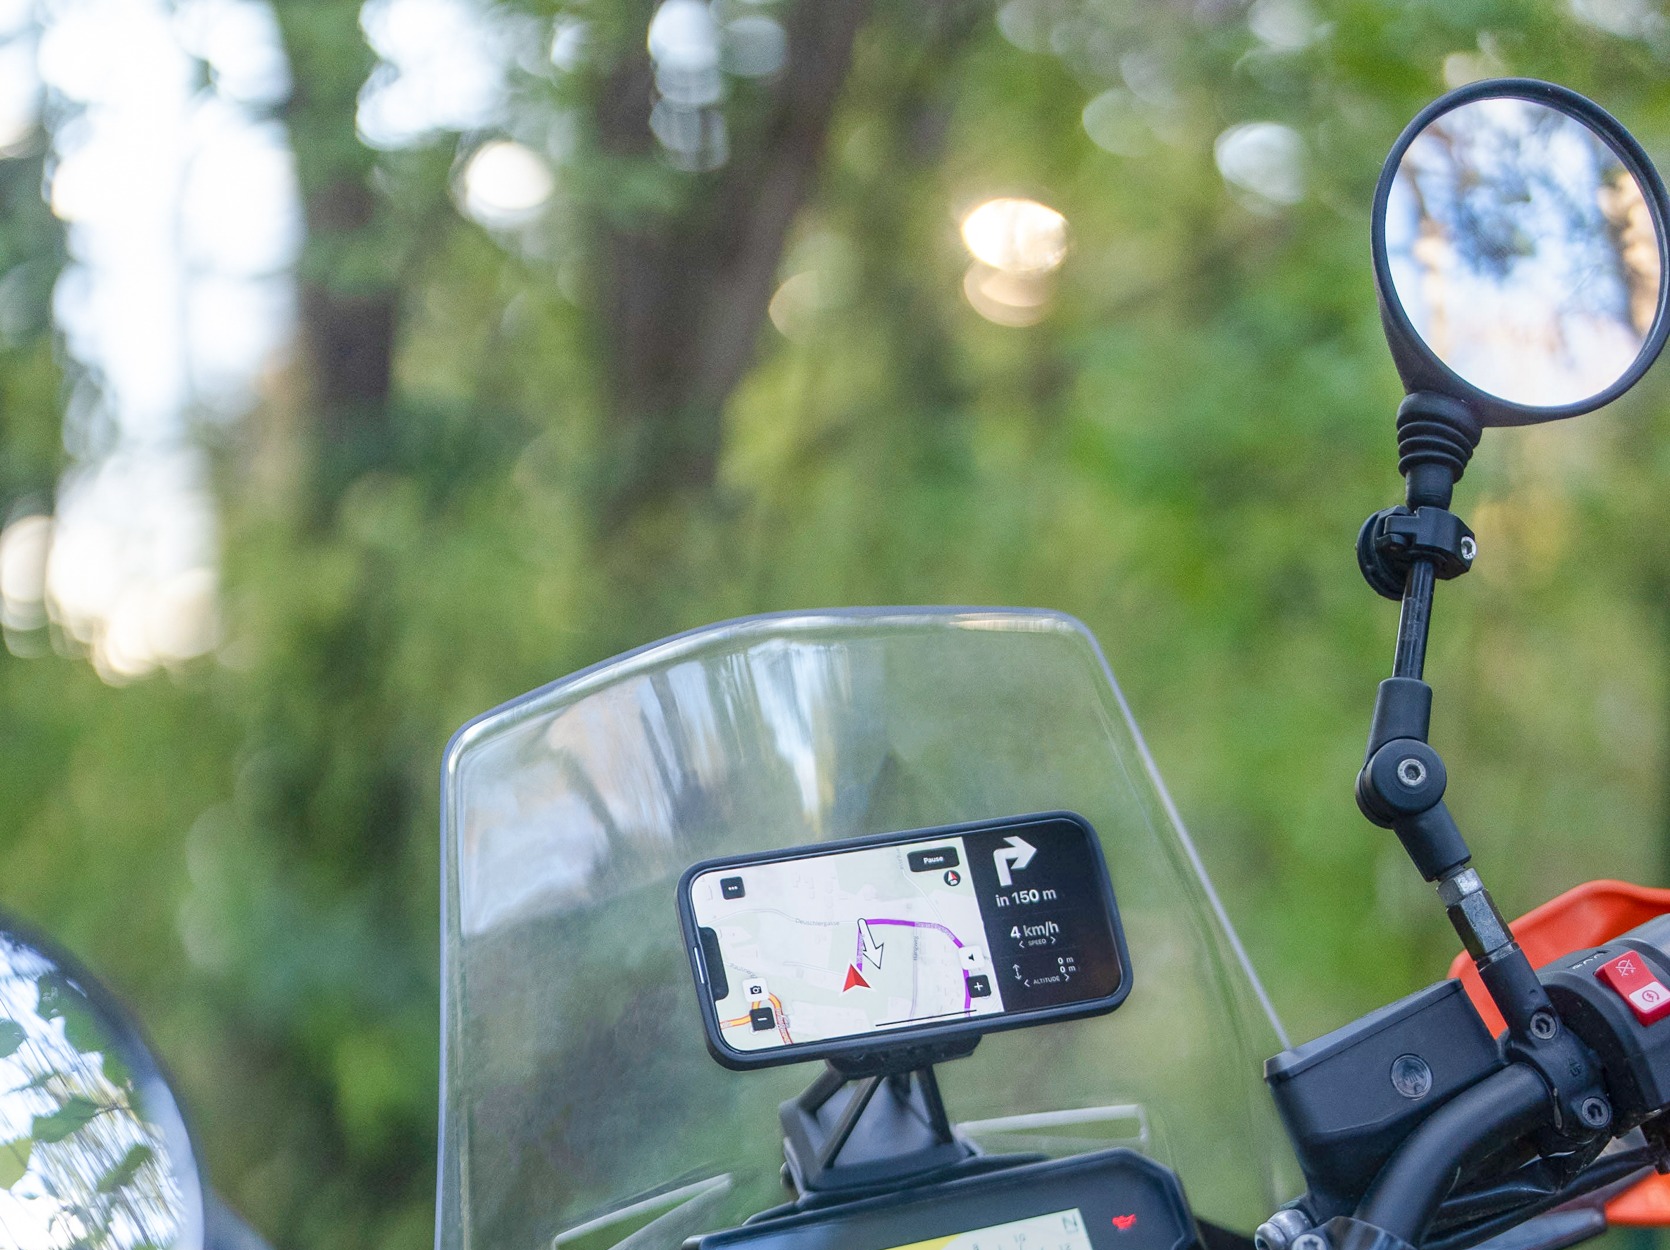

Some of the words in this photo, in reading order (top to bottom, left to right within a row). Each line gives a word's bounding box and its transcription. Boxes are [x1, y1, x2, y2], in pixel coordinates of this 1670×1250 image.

[923, 855, 944, 864] Pause
[996, 894, 1009, 907] in
[1012, 889, 1039, 904] 150
[1043, 889, 1057, 900] m
[1010, 926, 1020, 939] 4
[1023, 921, 1059, 937] km/h
[1028, 938, 1047, 947] SPEED
[1057, 957, 1063, 965] 0
[1033, 975, 1060, 985] ALTITUDE
